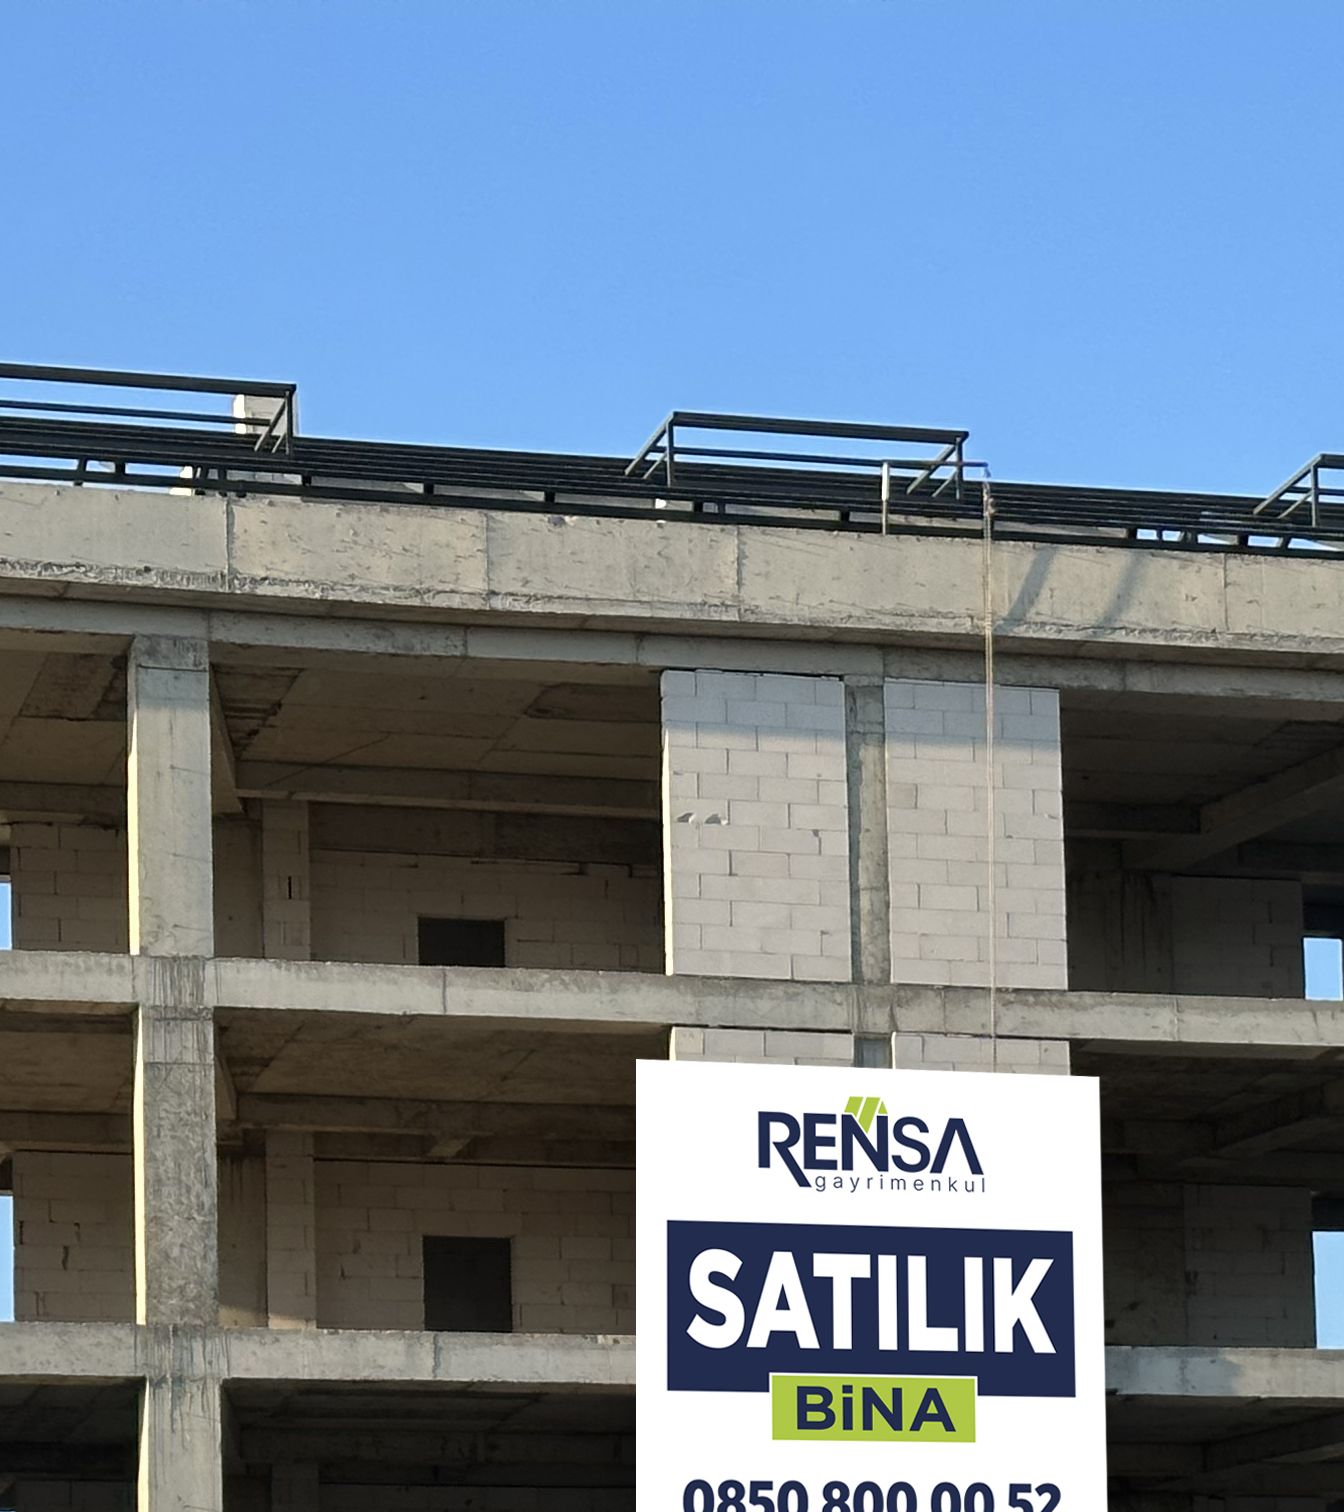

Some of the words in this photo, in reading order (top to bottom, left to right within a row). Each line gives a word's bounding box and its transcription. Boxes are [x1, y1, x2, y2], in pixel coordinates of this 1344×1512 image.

[758, 1110, 985, 1188] RENSA
[814, 1174, 985, 1193] gayrimenkul
[686, 1247, 1057, 1355] SATILIK
